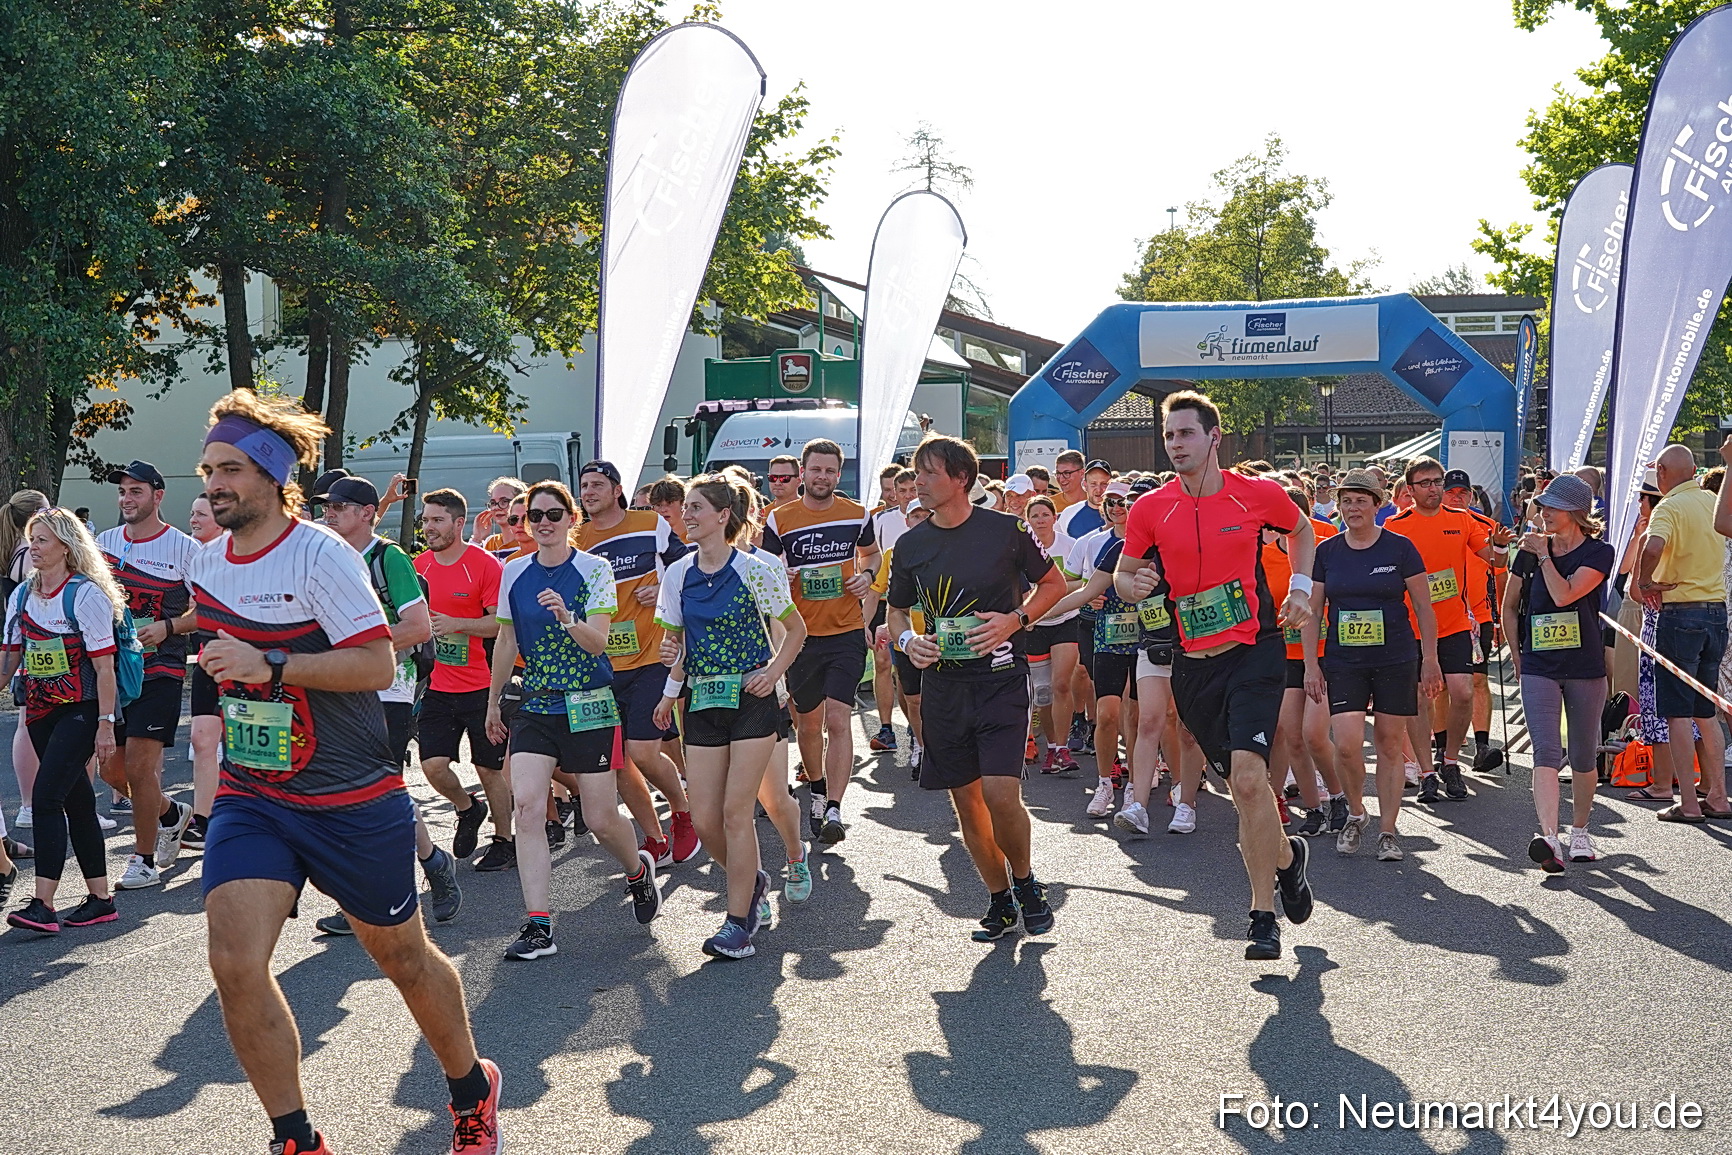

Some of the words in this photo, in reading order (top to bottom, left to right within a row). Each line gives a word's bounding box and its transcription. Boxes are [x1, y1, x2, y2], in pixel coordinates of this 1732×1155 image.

[1586, 190, 1629, 294] Fischer
[1254, 319, 1283, 329] Fischer
[1232, 335, 1320, 353] firmenlauf
[1062, 368, 1109, 379] Fischer
[720, 438, 760, 448] abavent
[802, 540, 853, 555] Fischer
[807, 551, 849, 560] AUTOMOBILE
[136, 558, 168, 569] NEUMARKT
[807, 577, 836, 591] 1861
[1432, 579, 1452, 592] 419
[238, 593, 282, 604] NEUMARKT
[1143, 606, 1163, 621] 887
[1190, 605, 1218, 624] 133
[1221, 602, 1233, 623] 2022
[1114, 623, 1136, 634] 700
[1348, 623, 1372, 635] 872
[1543, 625, 1567, 638] 873
[31, 653, 53, 666] 156
[701, 681, 726, 696] 689
[582, 700, 609, 717] 683
[237, 722, 270, 747] 115
[278, 730, 287, 761] 2022
[247, 748, 277, 758] Andreas
